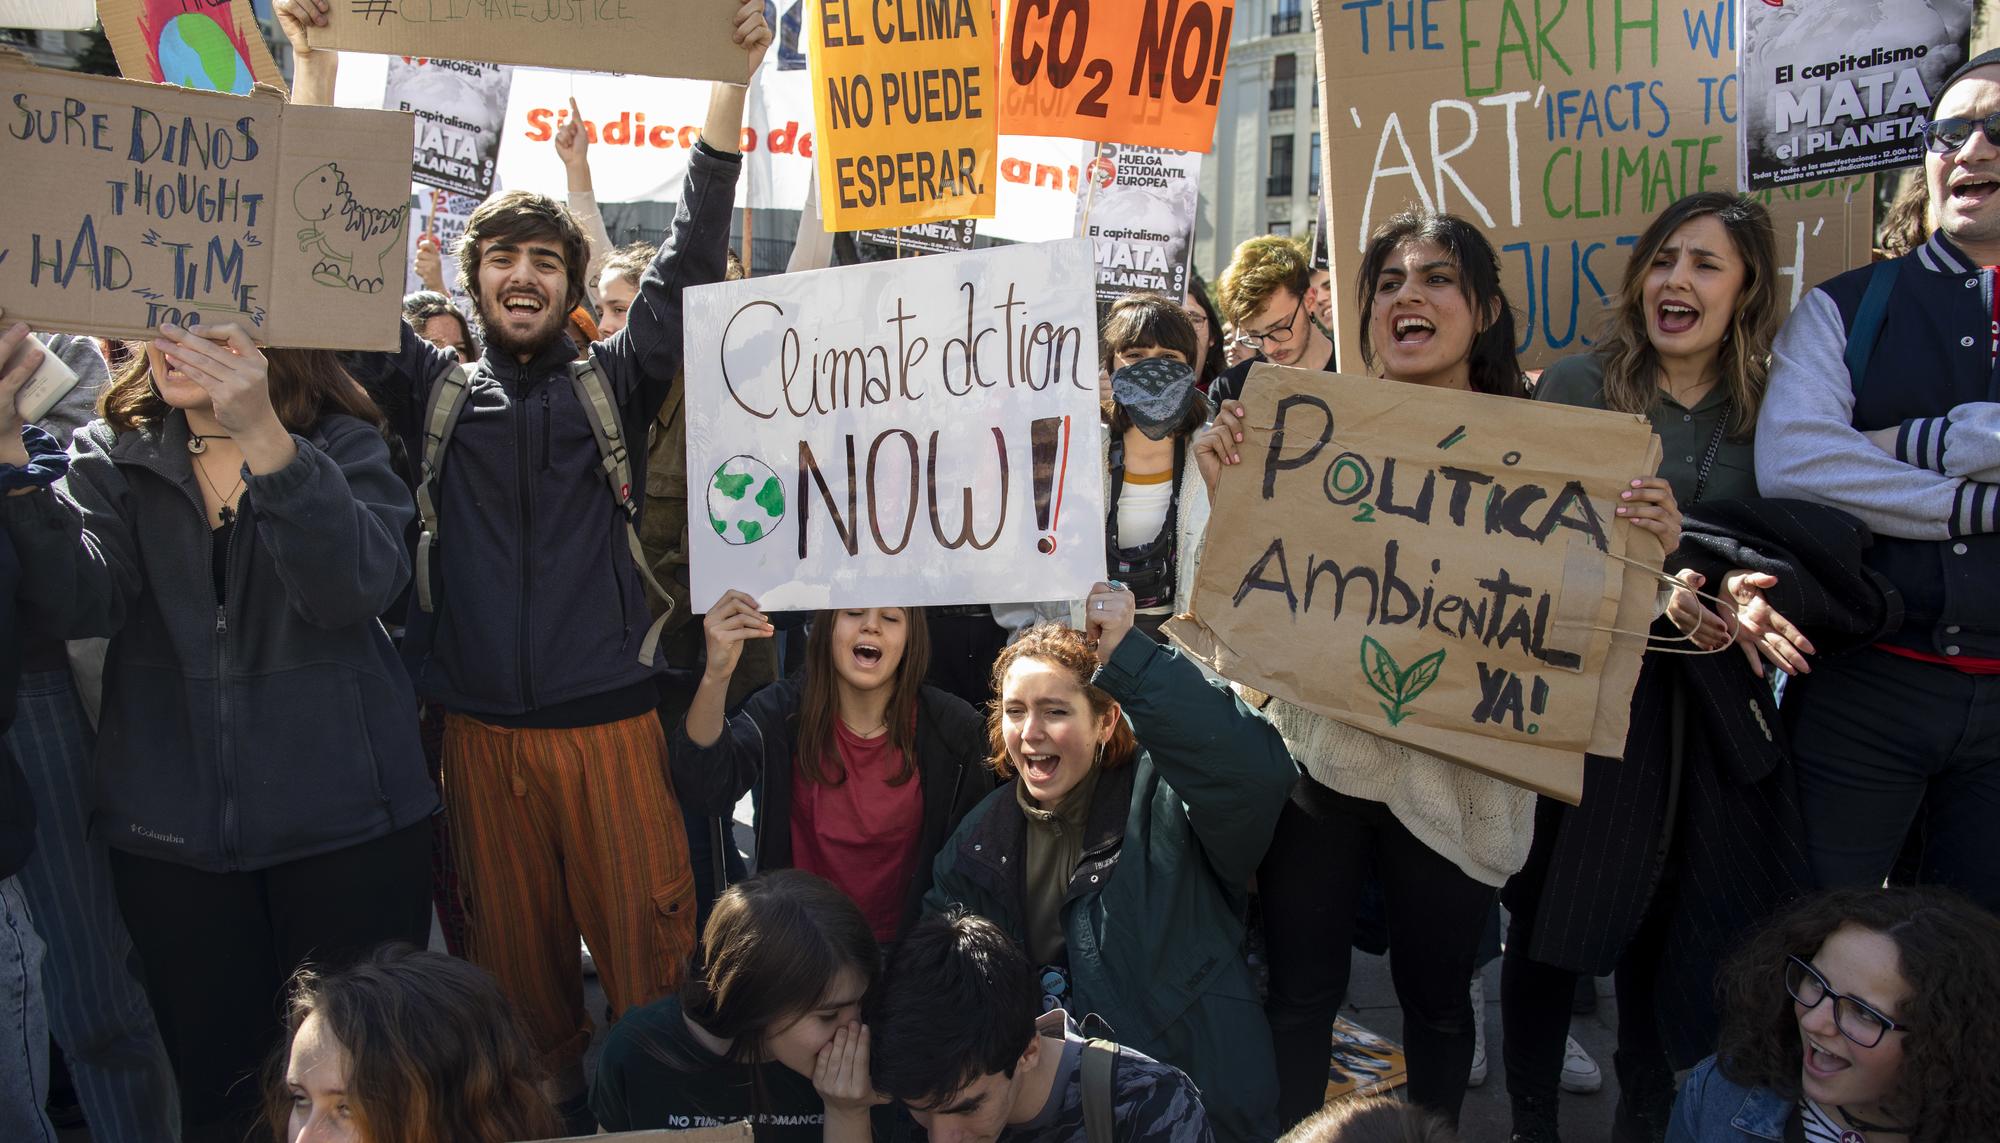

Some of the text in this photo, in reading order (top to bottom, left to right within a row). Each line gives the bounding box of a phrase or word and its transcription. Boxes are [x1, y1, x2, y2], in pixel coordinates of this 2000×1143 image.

[821, 0, 864, 47] EL
[872, 0, 977, 44] CLIMA
[1128, 0, 1233, 106] NO!
[1342, 0, 1735, 97] THE EARTH WI
[1776, 45, 1928, 84] El capitalismo
[414, 108, 481, 133] capitalismo
[828, 74, 873, 129] NO
[881, 66, 982, 125] PUEDE
[1776, 67, 1933, 134] MATA
[9, 93, 259, 170] SURE DINOS
[1119, 154, 1162, 166] HUELGA
[1776, 115, 1926, 160] el PLANETA
[106, 168, 264, 227] THOUGHT
[836, 147, 984, 209] ESPERAR.
[1117, 176, 1168, 188] EUROPEA
[1118, 165, 1186, 179] ESTUDIANTIL
[1542, 136, 1722, 219] CLIMATE
[30, 214, 258, 313] HAD TIME
[1089, 226, 1170, 242] El capitalismo
[1101, 271, 1167, 290] PLANETA
[1502, 235, 1645, 350] JUS
[721, 298, 929, 419] Climate
[1471, 660, 1549, 734] YA!
[137, 825, 184, 844] Columbia
[668, 1114, 690, 1128] NO
